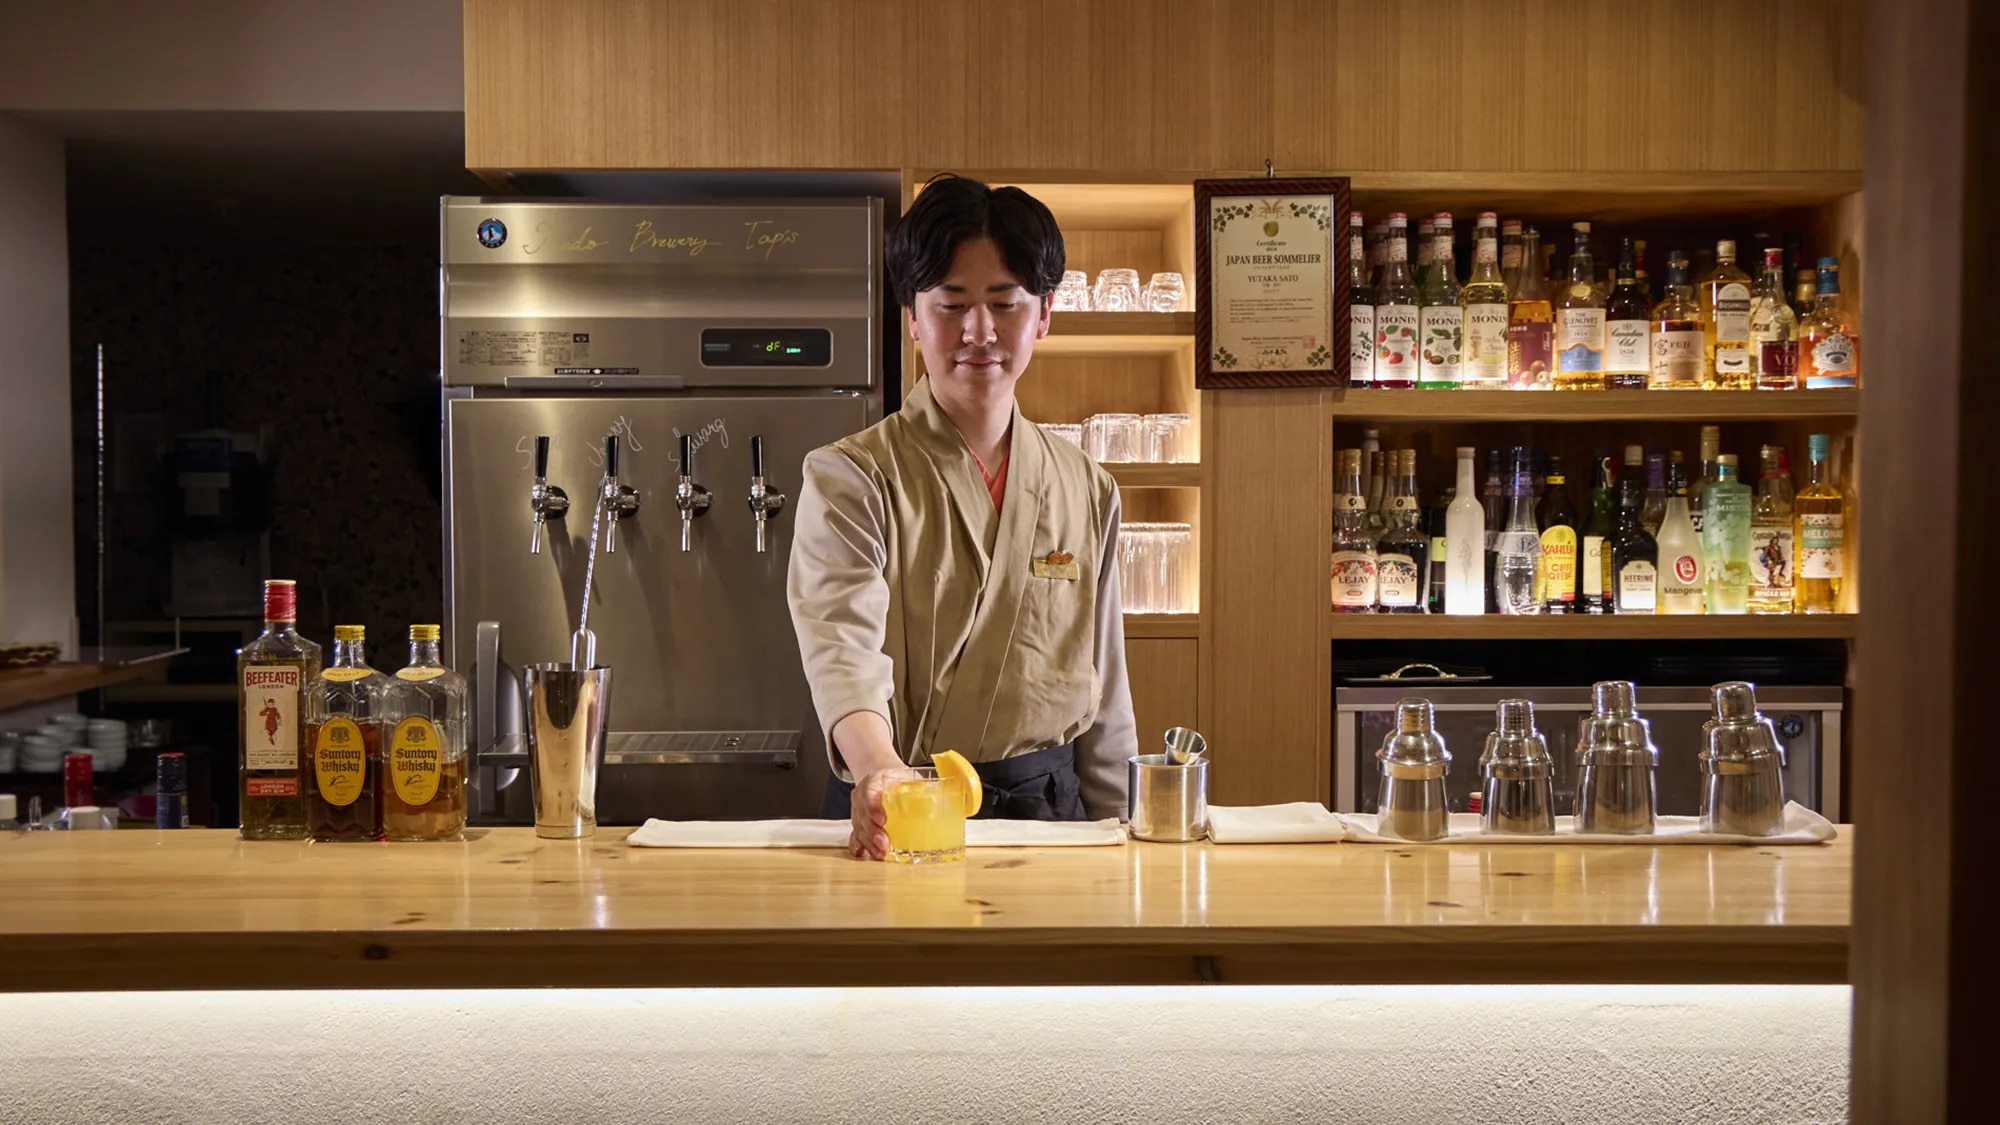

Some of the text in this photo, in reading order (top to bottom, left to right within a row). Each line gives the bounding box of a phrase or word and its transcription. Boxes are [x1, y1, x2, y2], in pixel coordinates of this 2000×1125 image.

[630, 219, 721, 257] Brewery
[1225, 253, 1321, 267] JAPAN BEER SOMMELIER
[1247, 274, 1299, 283] YUTAKA SATO
[1350, 316, 1372, 325] NIN
[1380, 315, 1417, 324] MONIN
[1610, 328, 1644, 337] Canadian
[1338, 575, 1370, 584] LEJAY
[1624, 574, 1653, 582] HEERING
[246, 671, 298, 688] BEEFEATER
[319, 748, 361, 761] Suntory
[395, 747, 437, 761] Suntory
[320, 760, 359, 774] Whisky
[397, 760, 436, 774] Whisky
